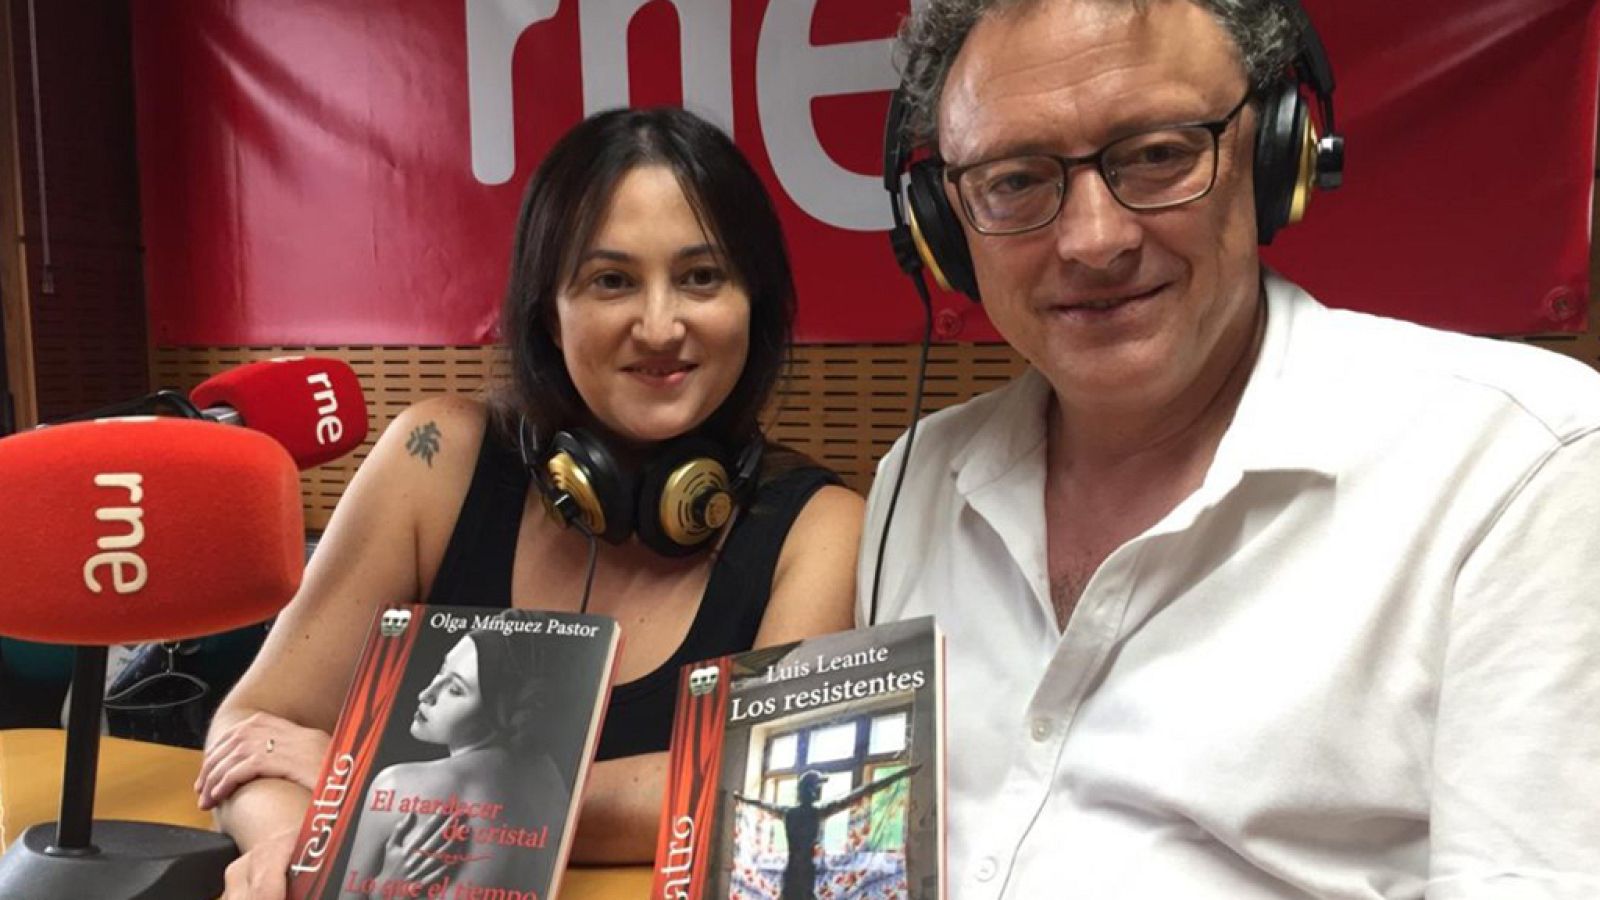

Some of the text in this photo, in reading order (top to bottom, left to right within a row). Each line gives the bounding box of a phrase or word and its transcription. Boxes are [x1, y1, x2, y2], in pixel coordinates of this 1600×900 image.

[307, 371, 344, 445] rne
[83, 472, 148, 594] rne
[430, 612, 600, 638] Olga Mínguez Pastor
[765, 645, 889, 683] Luis Leante
[729, 669, 926, 722] Los resistentes
[290, 753, 355, 876] teatro
[370, 788, 504, 821] El atardecer
[441, 815, 549, 849] de cristal
[660, 815, 695, 900] atro
[345, 869, 377, 895] Lo
[380, 879, 422, 900] que
[427, 875, 450, 899] el
